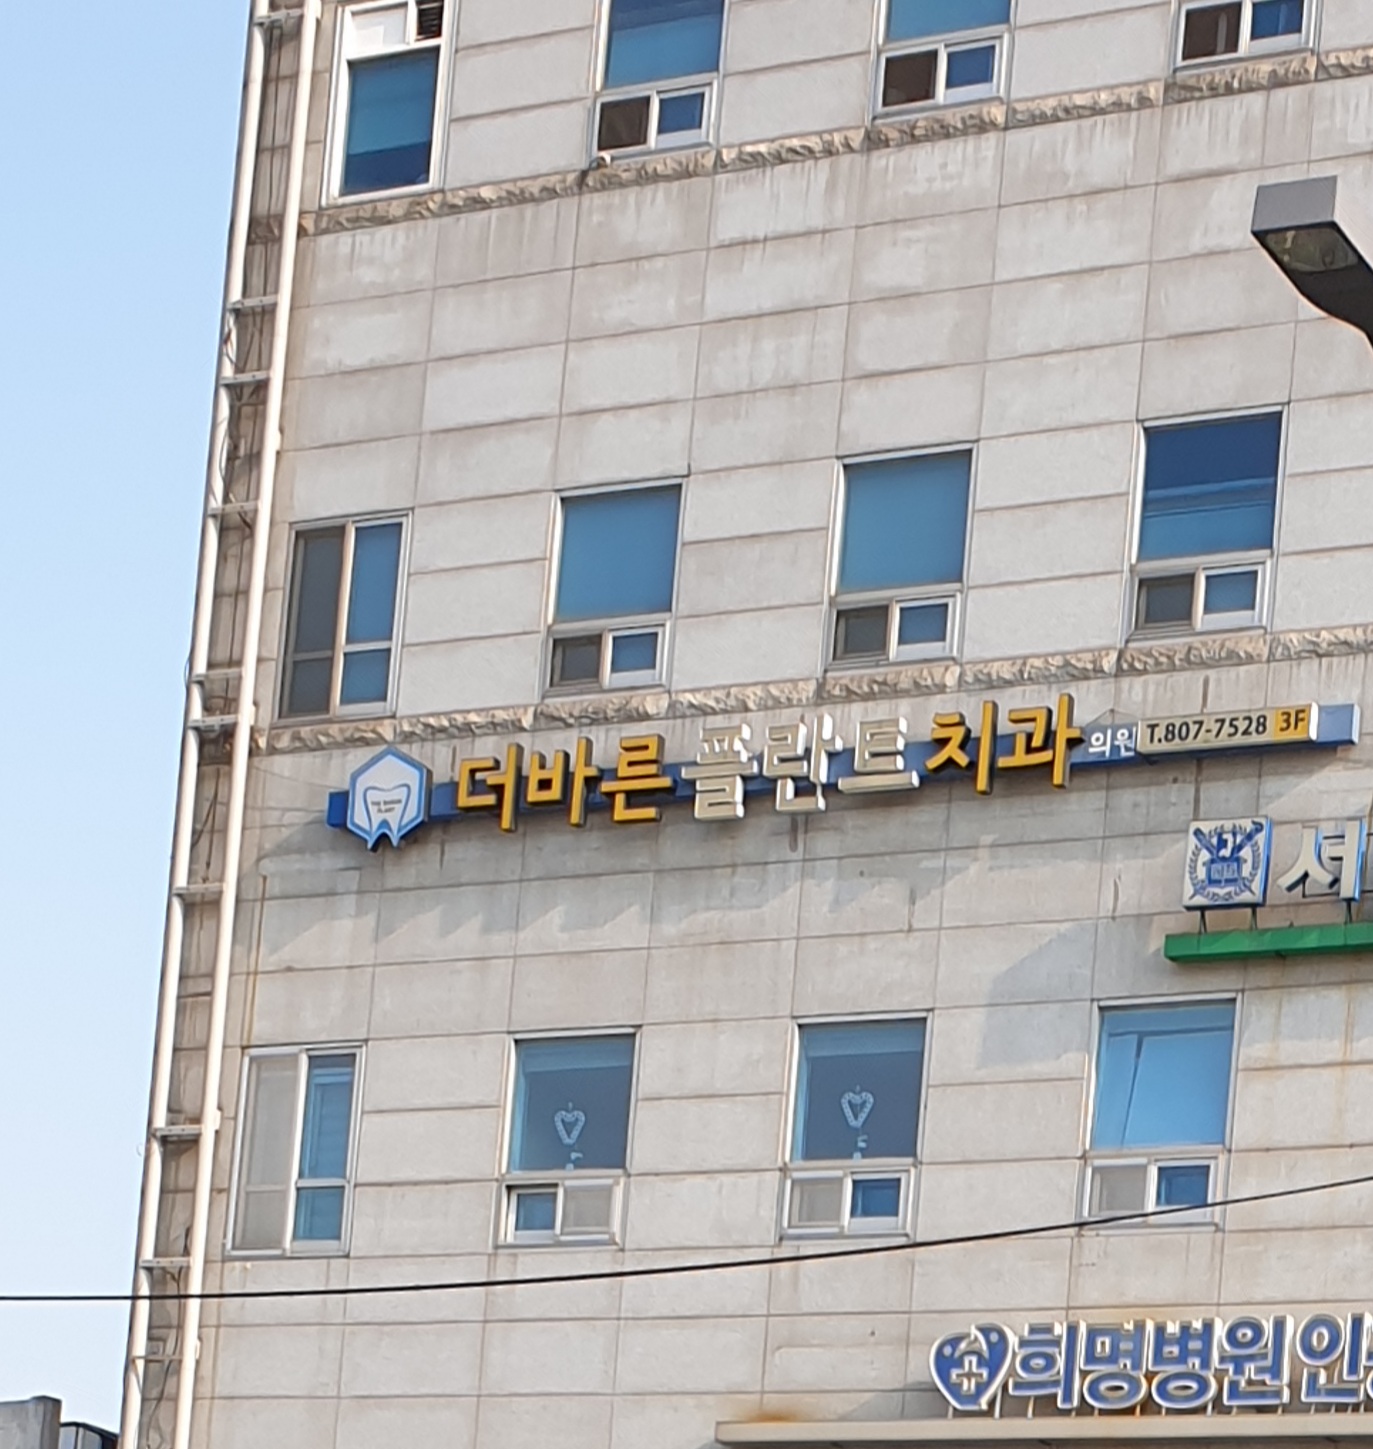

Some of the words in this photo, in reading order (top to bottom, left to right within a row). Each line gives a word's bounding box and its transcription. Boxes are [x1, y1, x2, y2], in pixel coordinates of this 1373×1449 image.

[1088, 725, 1137, 758] 의원
[1145, 714, 1268, 745] T.807-7528
[1279, 709, 1307, 731] 3F
